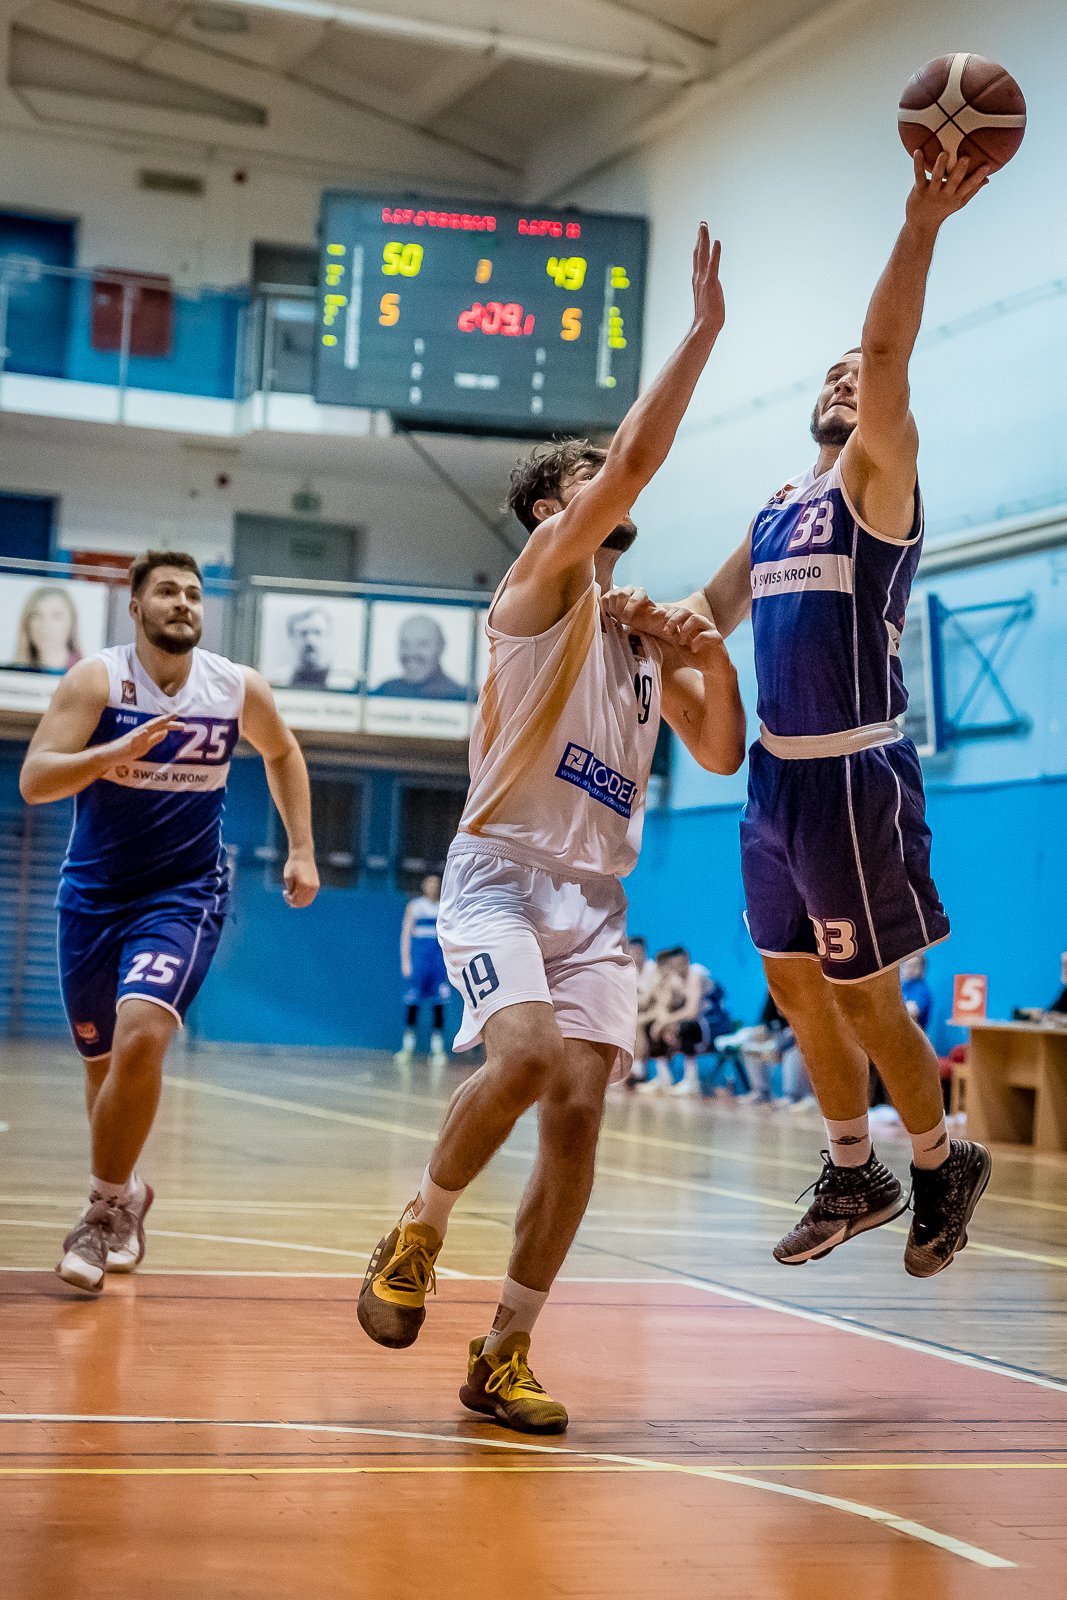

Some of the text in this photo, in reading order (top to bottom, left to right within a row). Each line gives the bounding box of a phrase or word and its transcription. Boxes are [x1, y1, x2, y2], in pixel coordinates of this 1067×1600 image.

[381, 241, 424, 277] 50
[546, 256, 588, 290] 49
[378, 292, 401, 327] 5
[560, 307, 583, 341] 5
[789, 500, 835, 550] 33
[177, 722, 230, 761] 25
[132, 769, 169, 781] SWISS
[123, 951, 183, 986] 25
[461, 952, 500, 1009] 19
[958, 978, 985, 1011] 5
